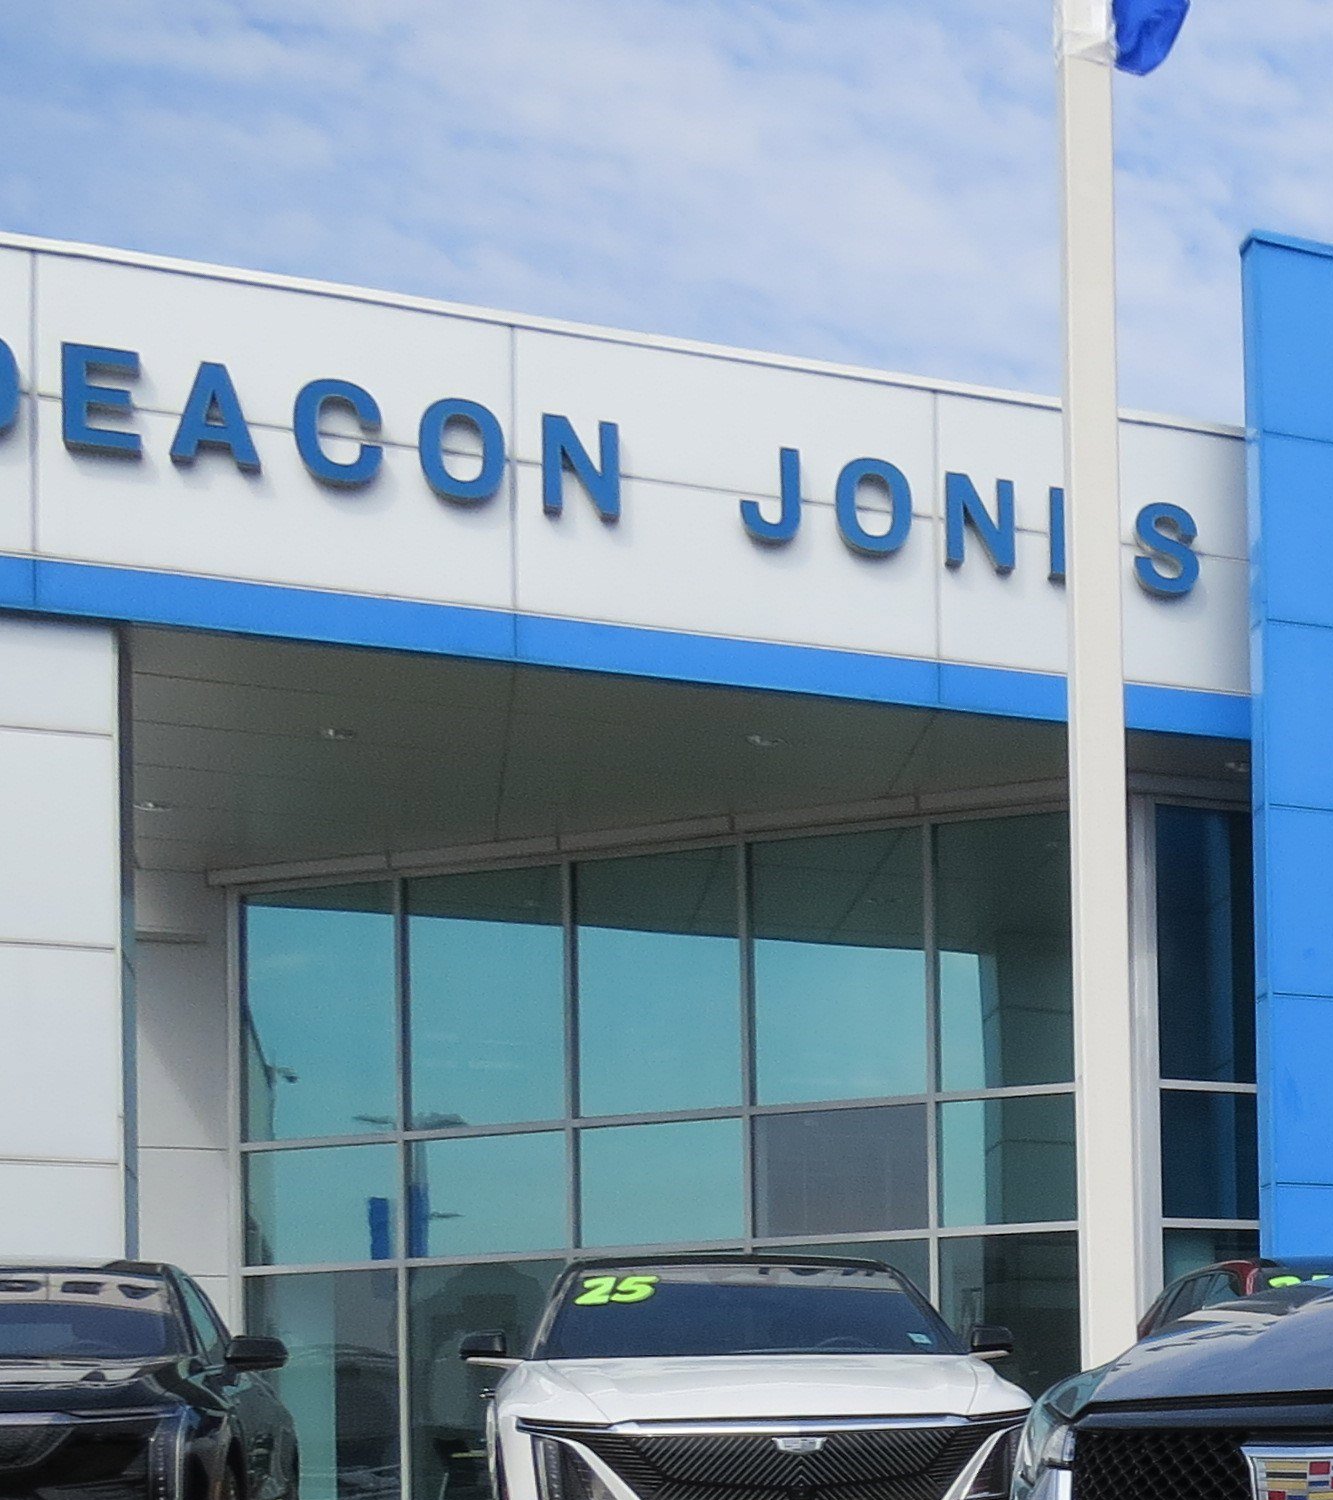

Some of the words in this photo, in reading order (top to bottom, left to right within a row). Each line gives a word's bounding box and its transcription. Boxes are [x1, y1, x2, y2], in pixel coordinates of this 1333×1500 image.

[0, 338, 622, 524] EACON
[740, 447, 1201, 598] JONS
[574, 1274, 660, 1307] 25
